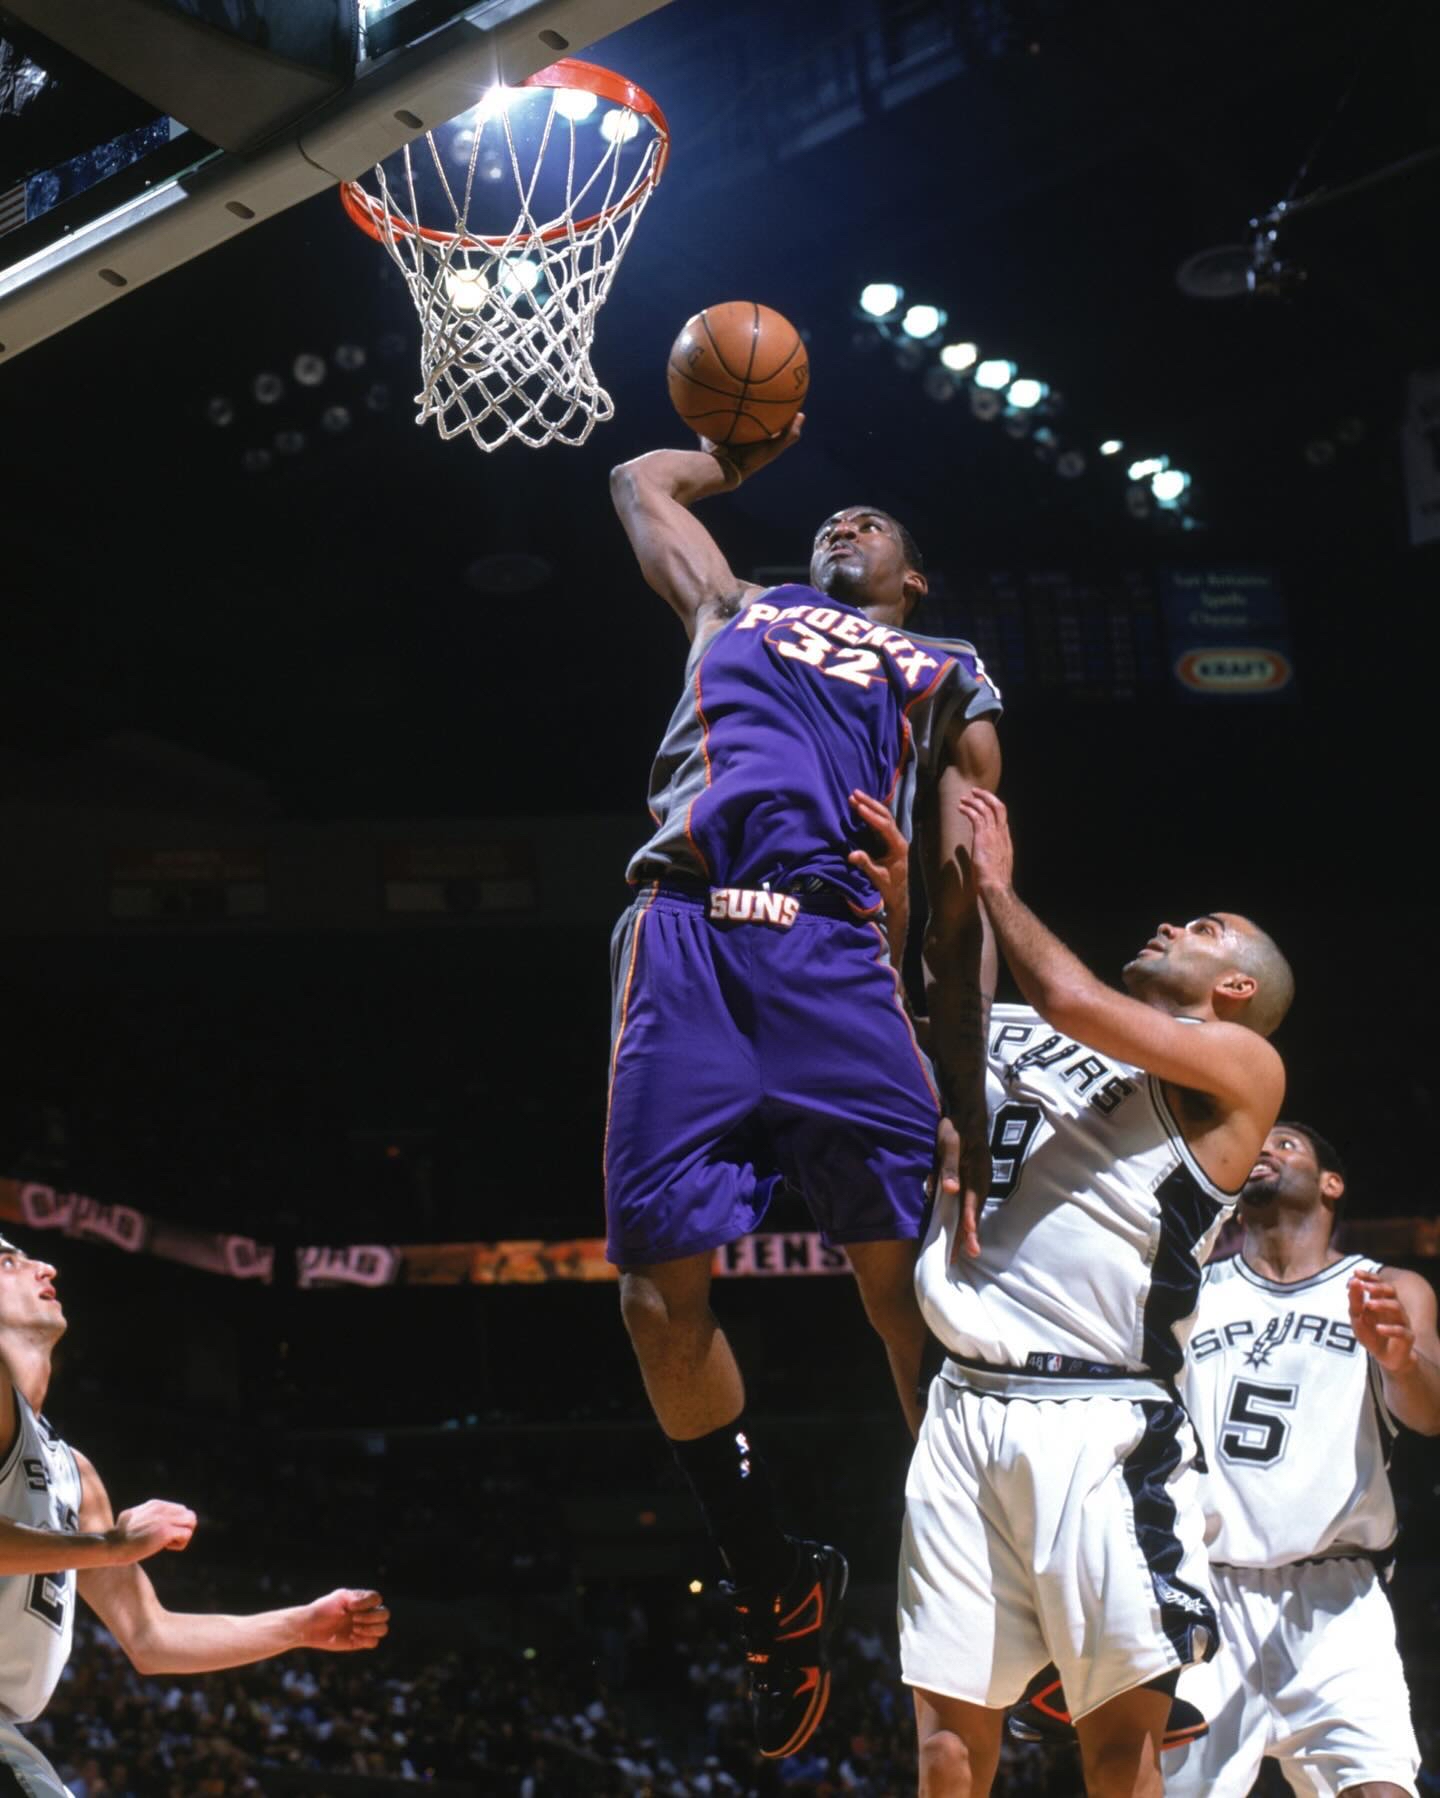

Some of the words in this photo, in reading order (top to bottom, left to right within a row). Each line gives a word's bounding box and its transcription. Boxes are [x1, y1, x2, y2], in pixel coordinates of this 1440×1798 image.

[776, 621, 881, 688] 32
[709, 887, 800, 927] SUNS
[990, 1024, 1136, 1115] PURS
[987, 1099, 1045, 1201] 9
[723, 1235, 848, 1272] FENS
[1189, 1311, 1361, 1371] SPURS
[1219, 1376, 1299, 1470] 5
